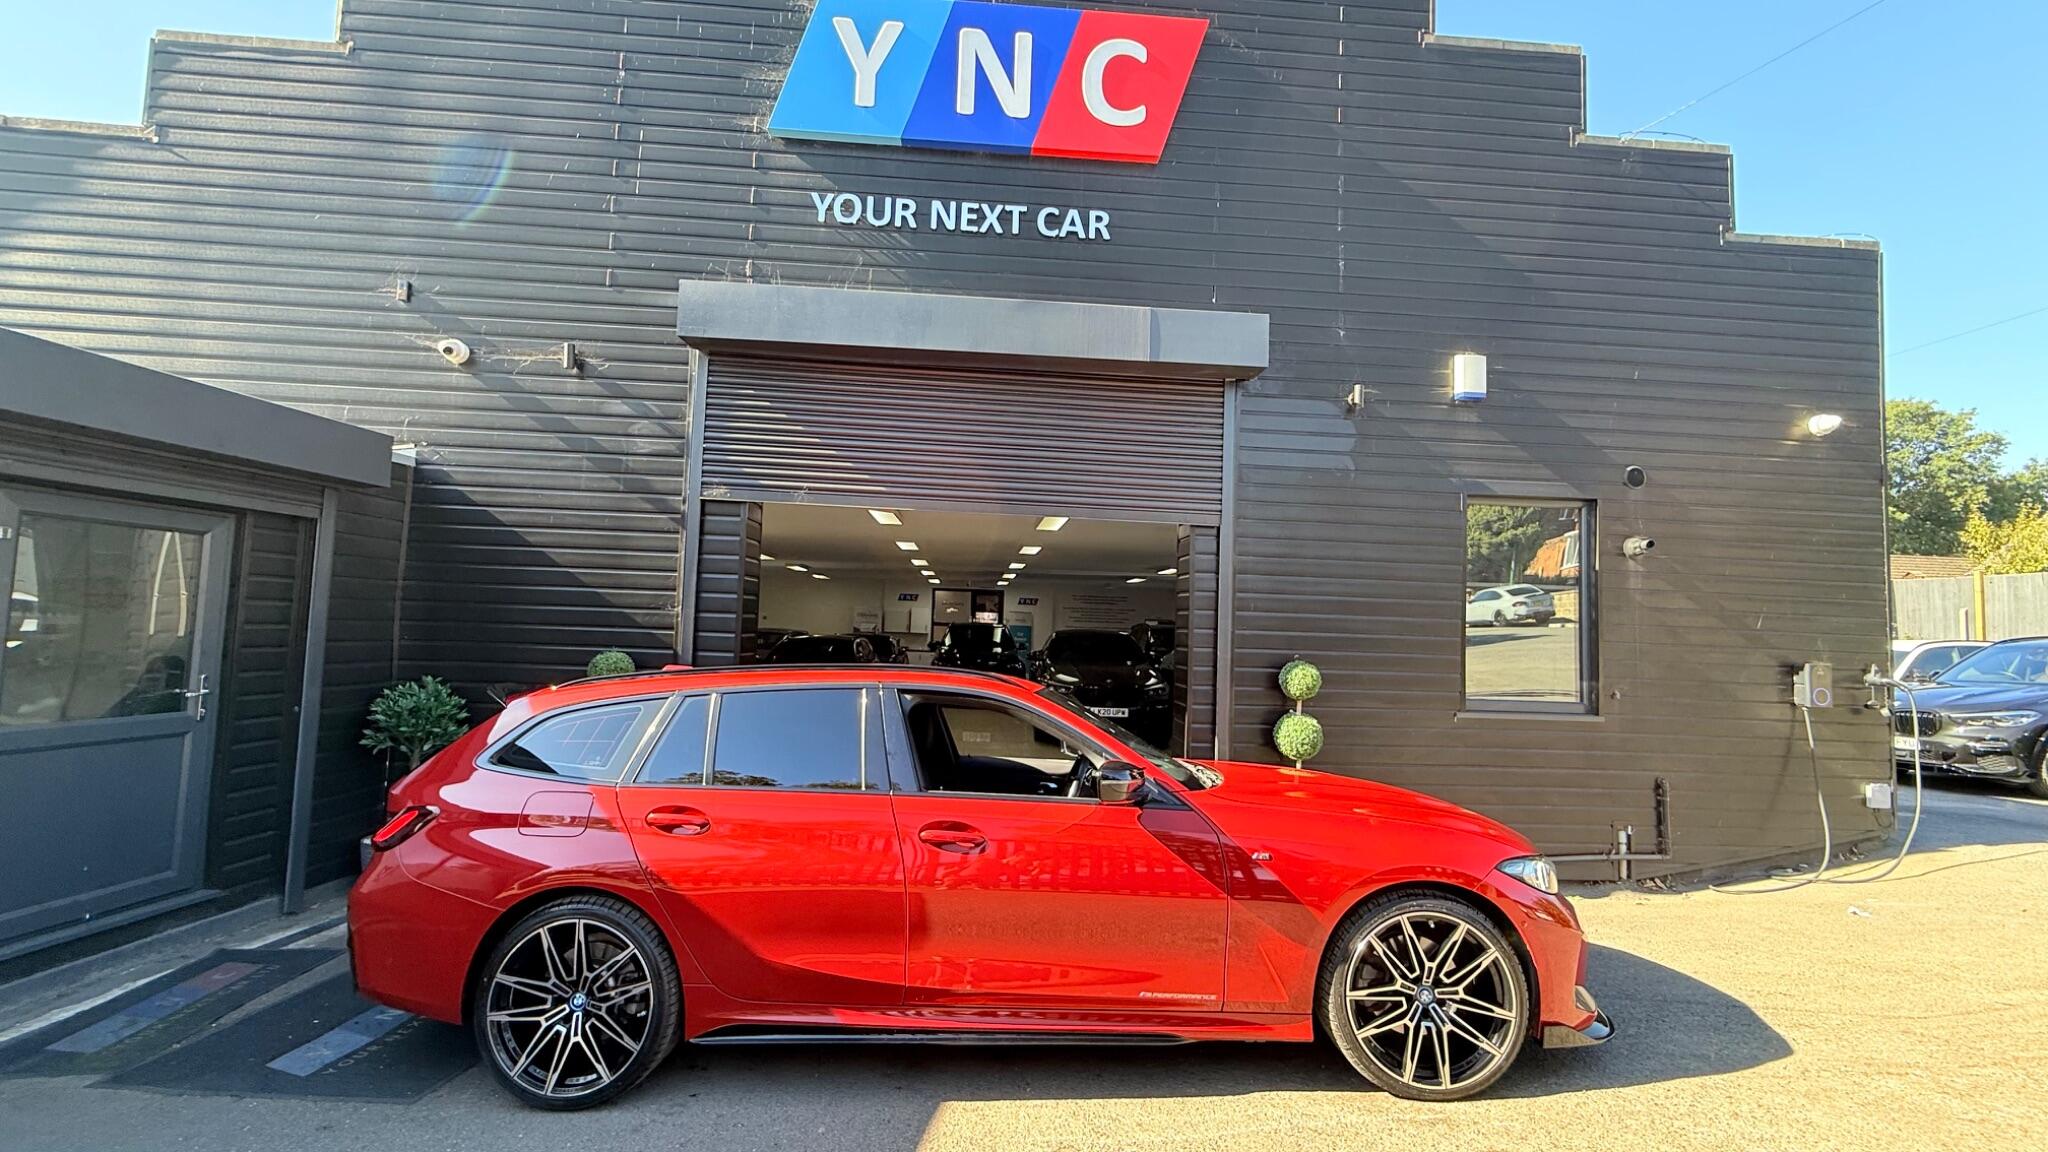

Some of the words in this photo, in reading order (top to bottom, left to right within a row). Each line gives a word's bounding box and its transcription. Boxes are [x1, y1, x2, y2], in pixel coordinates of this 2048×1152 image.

[832, 16, 1148, 127] YNC
[810, 191, 917, 228] YOUR
[930, 199, 1028, 235] NEXT
[1036, 206, 1111, 240] CAR
[1153, 992, 1217, 1000] PERFORMANCE
